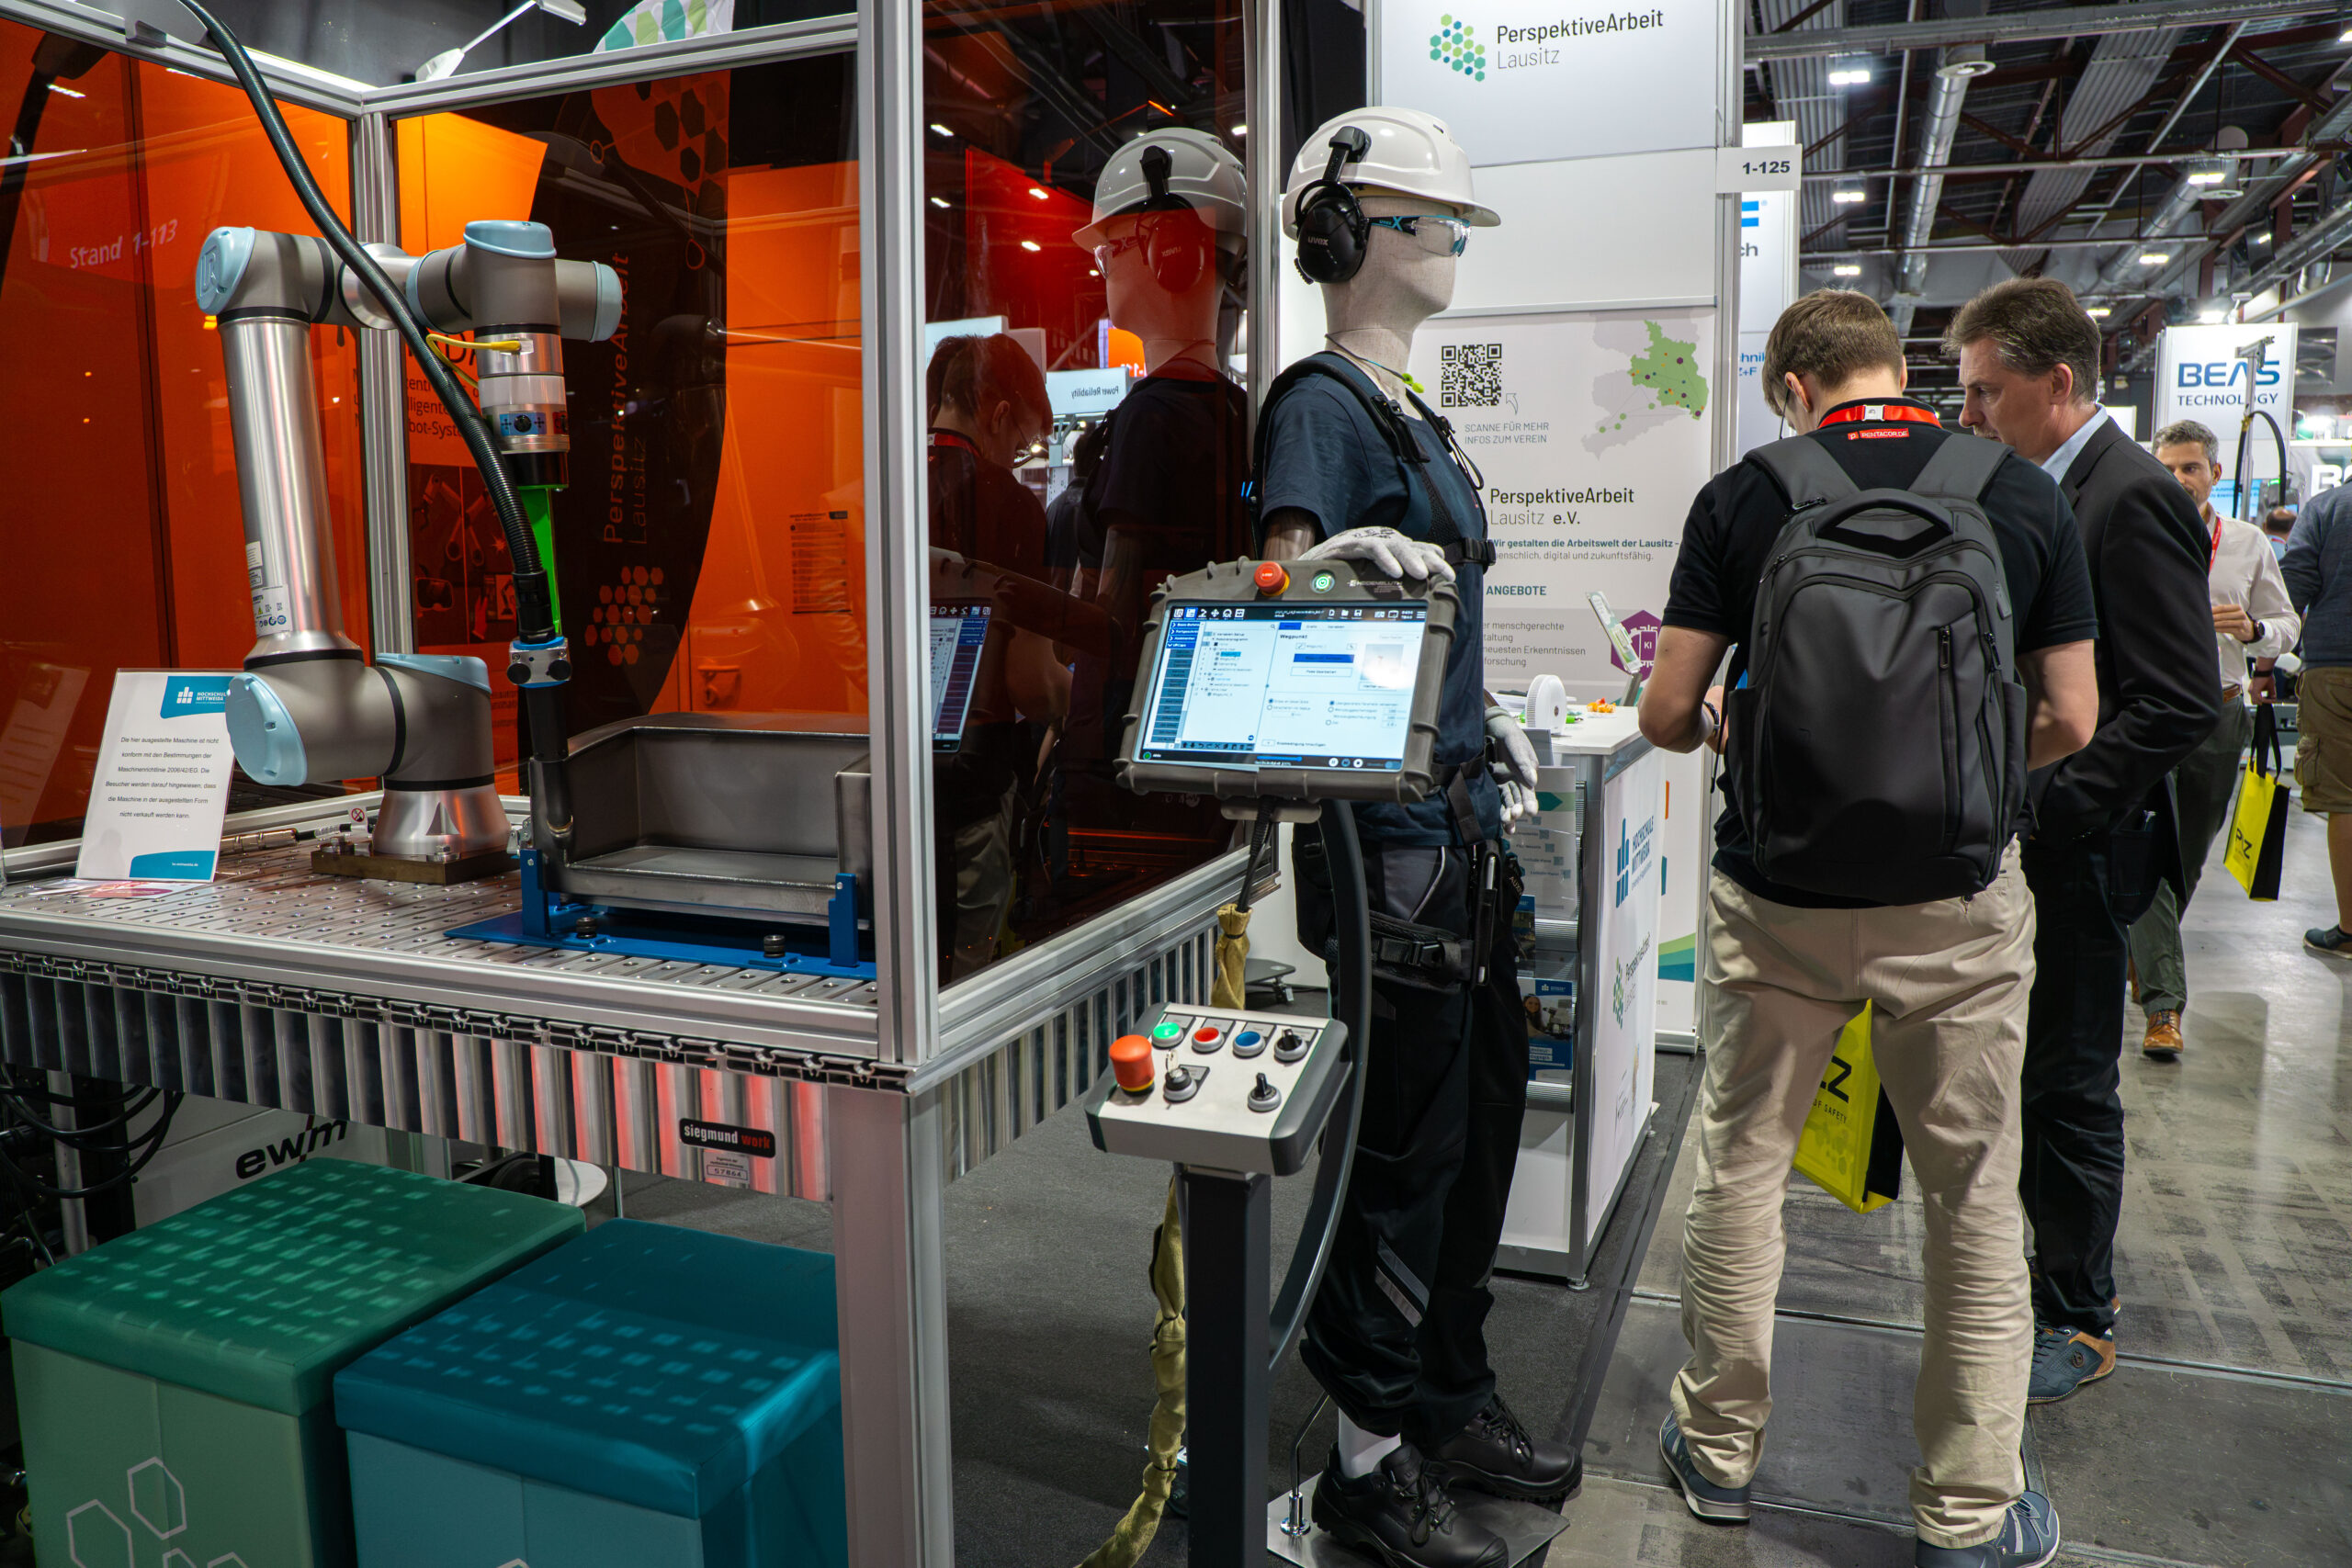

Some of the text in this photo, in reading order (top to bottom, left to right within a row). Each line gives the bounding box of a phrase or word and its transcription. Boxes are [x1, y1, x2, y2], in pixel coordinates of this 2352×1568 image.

[1497, 10, 1664, 44] PerspektiveArbeit
[1498, 47, 1560, 70] Lausitz
[1742, 161, 1791, 175] 1-125
[70, 219, 178, 268] Stand 1-113
[1307, 236, 1329, 246] uvex
[2177, 360, 2280, 388] BEAS
[2177, 393, 2278, 406] TECHNOLGY
[1464, 422, 1549, 433] SCANNE FÜR MEHR
[1861, 430, 1908, 438] PENTACOR.DE
[1464, 434, 1547, 445] INFOS ZUM VEREIN
[1490, 487, 1634, 506] PerspektiveArbeit
[1490, 510, 1580, 525] Lausitz e.V.
[1508, 539, 1549, 549] gestalten
[1551, 539, 1565, 547] die
[1566, 539, 1620, 547] Arbeitswelt
[1622, 539, 1637, 547] der
[1639, 539, 1673, 547] Lausitz
[1544, 551, 1571, 561] digital
[1572, 551, 1589, 559] und
[1590, 551, 1655, 562] zukunftsfähig.
[1486, 585, 1547, 596] ANGEBOTE
[1492, 622, 1565, 631] menschgerechte
[1484, 633, 1513, 643] taltung
[1523, 646, 1586, 655] Erkenntnissen
[1644, 641, 1653, 649] KI
[1484, 657, 1527, 667] forschung
[1632, 815, 1654, 853] HOCHSCHULE
[1632, 839, 1650, 875] MITTWEIDA
[1824, 1105, 1848, 1124] SAFETY
[684, 1123, 771, 1150] siegmund work
[235, 1119, 348, 1179] ewm
